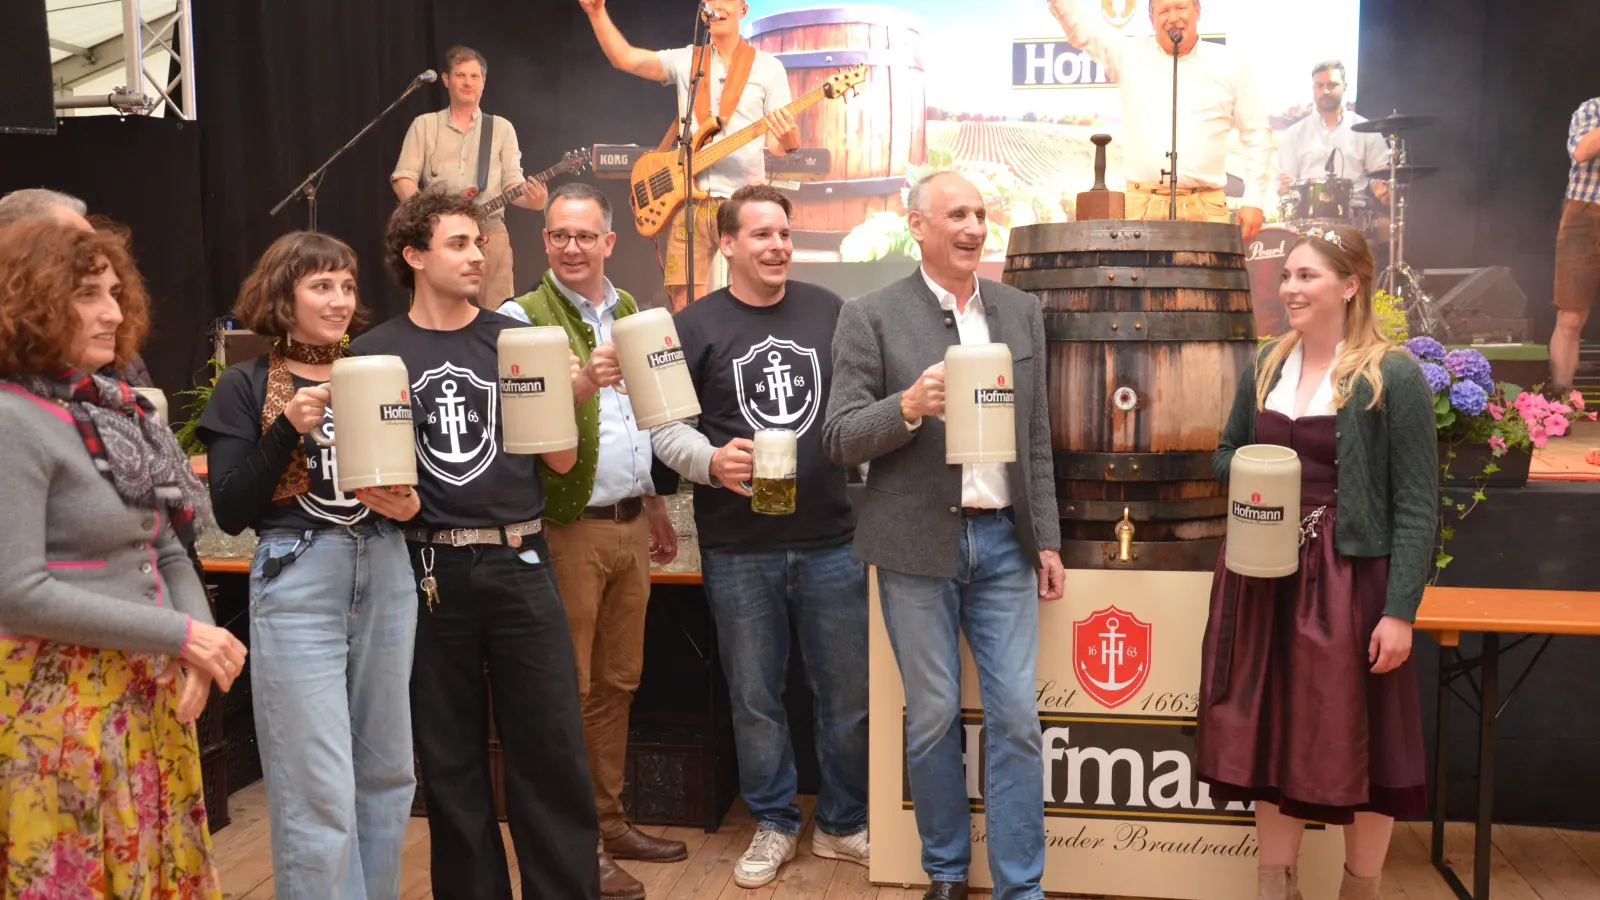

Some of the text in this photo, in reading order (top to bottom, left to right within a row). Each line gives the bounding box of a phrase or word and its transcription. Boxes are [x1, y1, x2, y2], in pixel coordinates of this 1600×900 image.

[600, 154, 628, 165] KORG
[1245, 240, 1285, 261] Pearl
[755, 381, 765, 393] 16
[793, 375, 805, 387] 63
[467, 409, 479, 423] 63
[306, 455, 317, 469] 16
[1234, 502, 1281, 520] Hofmann
[1088, 645, 1097, 656] 16
[1126, 646, 1137, 658] 63
[1140, 692, 1200, 712] 1663
